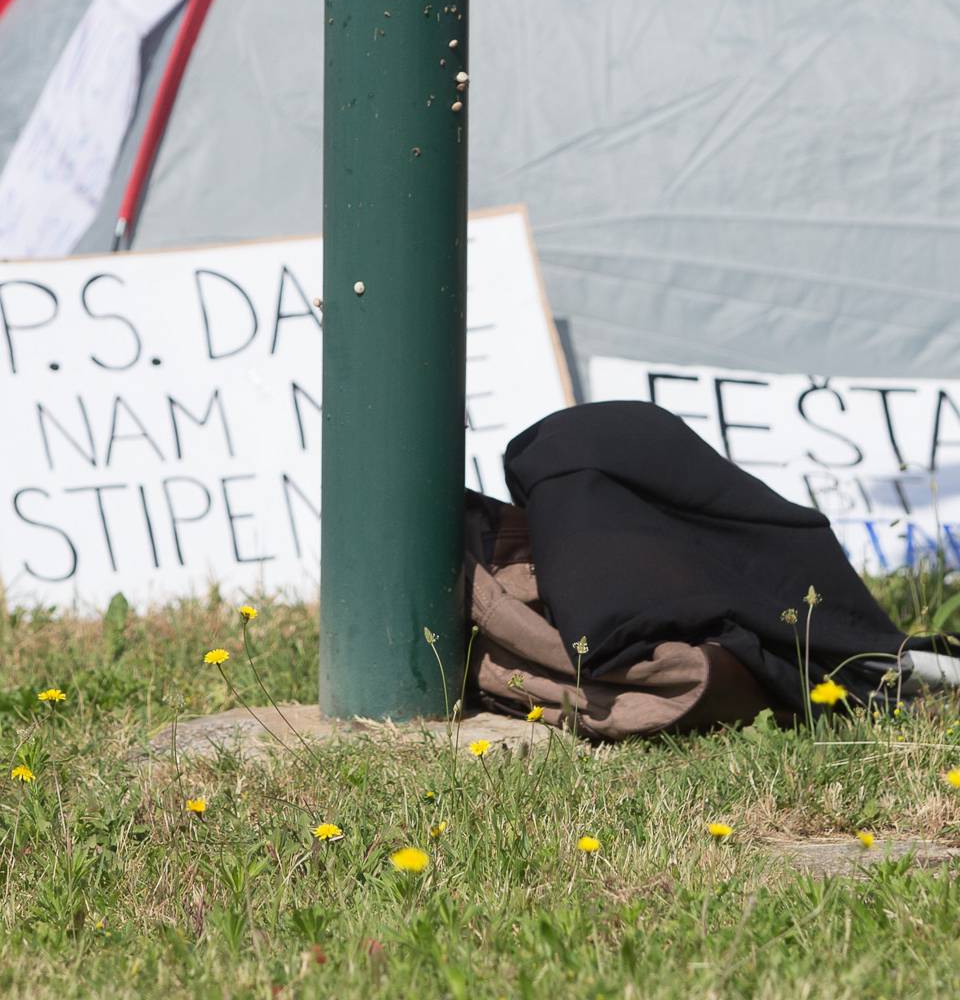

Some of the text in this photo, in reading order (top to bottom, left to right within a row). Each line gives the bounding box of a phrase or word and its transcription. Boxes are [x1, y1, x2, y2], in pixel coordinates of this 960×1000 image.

[0, 273, 162, 374] P.S.
[36, 388, 236, 468] NAM
[803, 471, 924, 518] BIT
